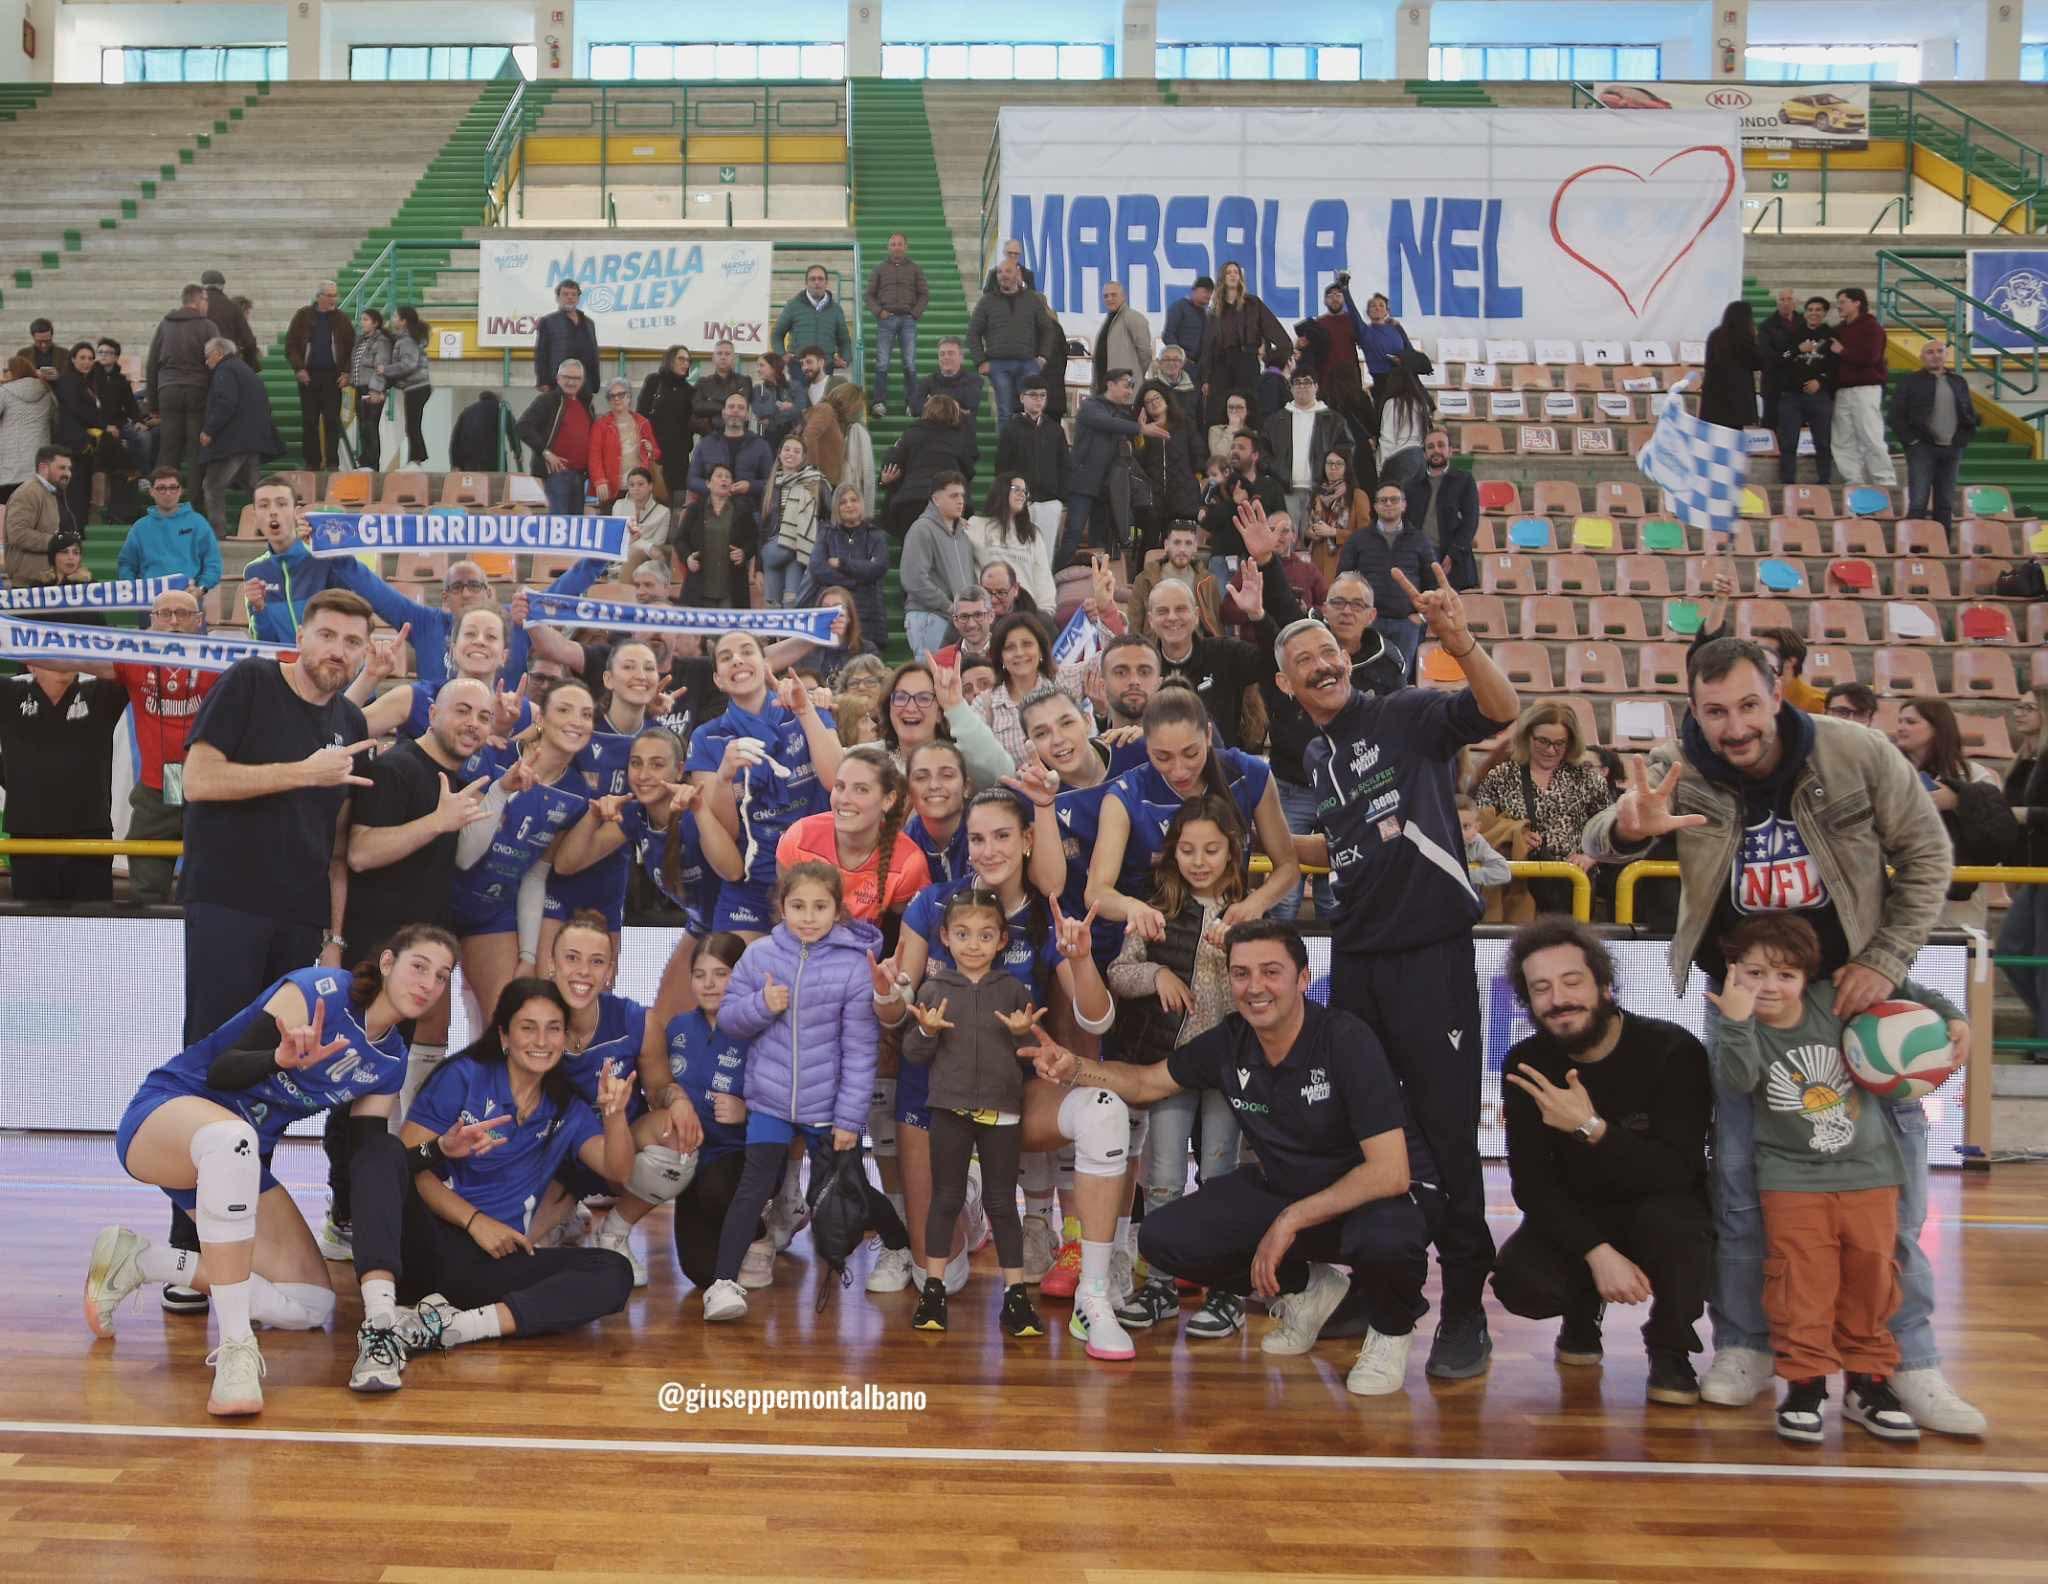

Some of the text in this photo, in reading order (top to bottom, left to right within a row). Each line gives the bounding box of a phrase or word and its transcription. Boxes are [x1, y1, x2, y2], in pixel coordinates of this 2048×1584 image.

[1713, 94, 1745, 105] KIA
[545, 245, 704, 288] MARSALA
[1010, 193, 1523, 319] MARSALA NEL
[487, 315, 541, 336] IMEX
[627, 315, 677, 329] CLUB
[703, 320, 762, 343] IMEX
[358, 514, 604, 549] GLI IRRIDUCIBILI
[10, 626, 186, 658] MARSALA
[610, 769, 625, 793] 15
[516, 815, 532, 840] 5
[1743, 860, 1821, 908] NFL
[325, 1047, 362, 1082] 10
